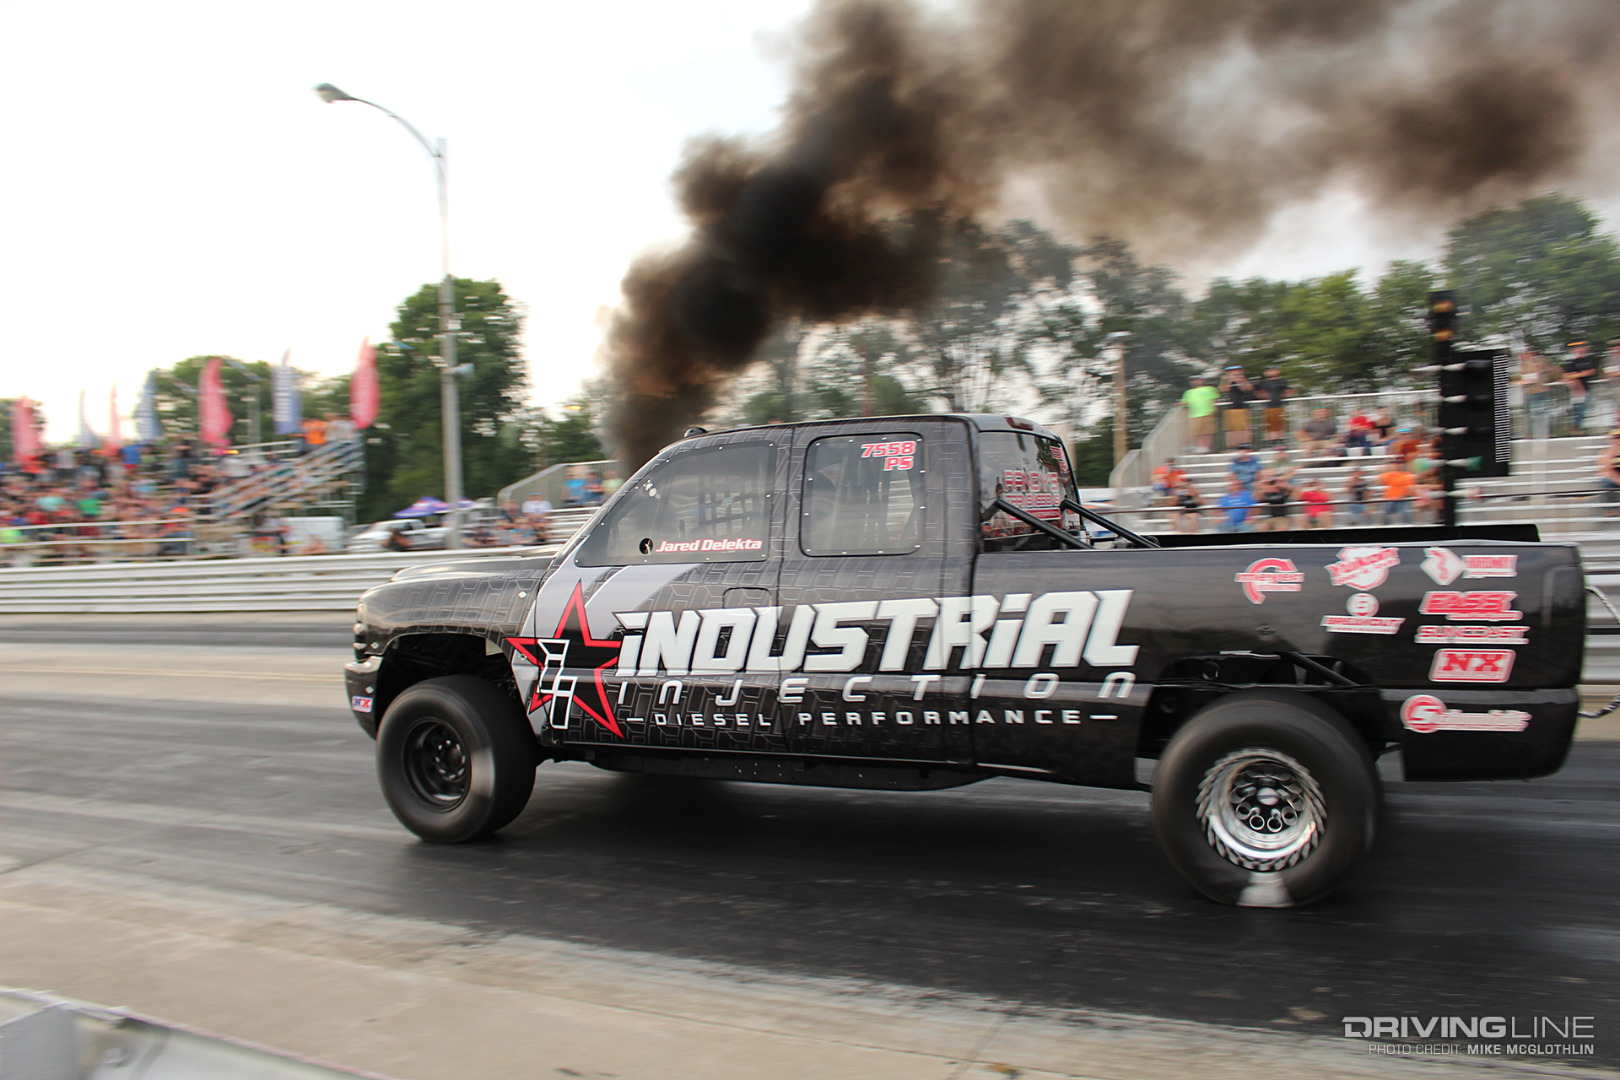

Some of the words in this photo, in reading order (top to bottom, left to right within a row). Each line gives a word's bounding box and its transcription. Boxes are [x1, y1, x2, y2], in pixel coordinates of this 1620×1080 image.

[861, 441, 916, 457] 7558
[883, 456, 914, 471] PS
[656, 540, 700, 552] Jared
[701, 538, 763, 552] Delekta
[1442, 653, 1503, 672] NX
[655, 713, 772, 726] DIESEL
[798, 710, 1081, 726] PERFORMANCE
